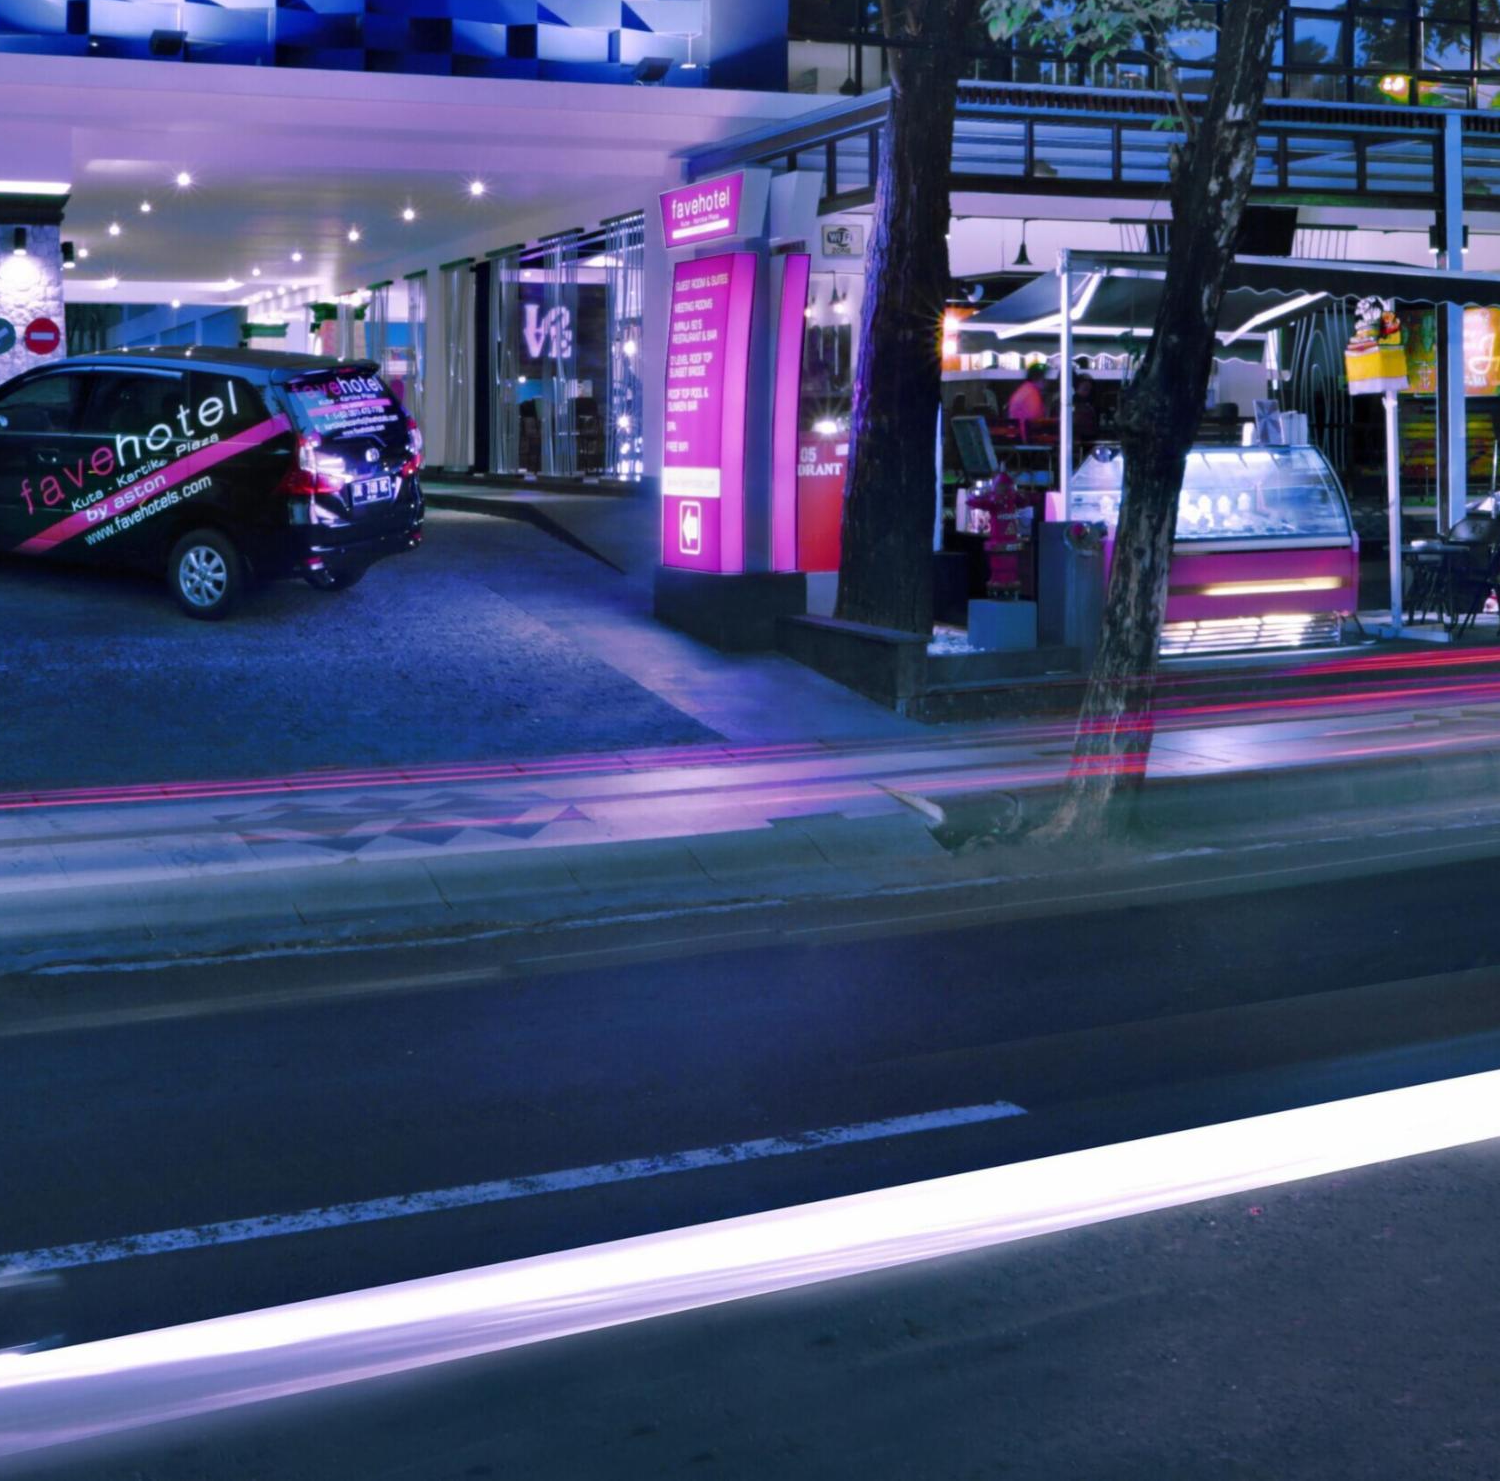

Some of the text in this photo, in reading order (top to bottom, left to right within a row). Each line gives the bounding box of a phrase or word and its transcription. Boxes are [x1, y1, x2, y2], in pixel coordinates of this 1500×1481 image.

[671, 185, 731, 221] favehotel
[20, 380, 239, 516] favehotel
[71, 488, 105, 512] Kuta
[116, 458, 169, 489] Kartika
[175, 432, 220, 457] Plaza
[84, 475, 213, 547] www.favehotels.com
[85, 474, 167, 523] by aston
